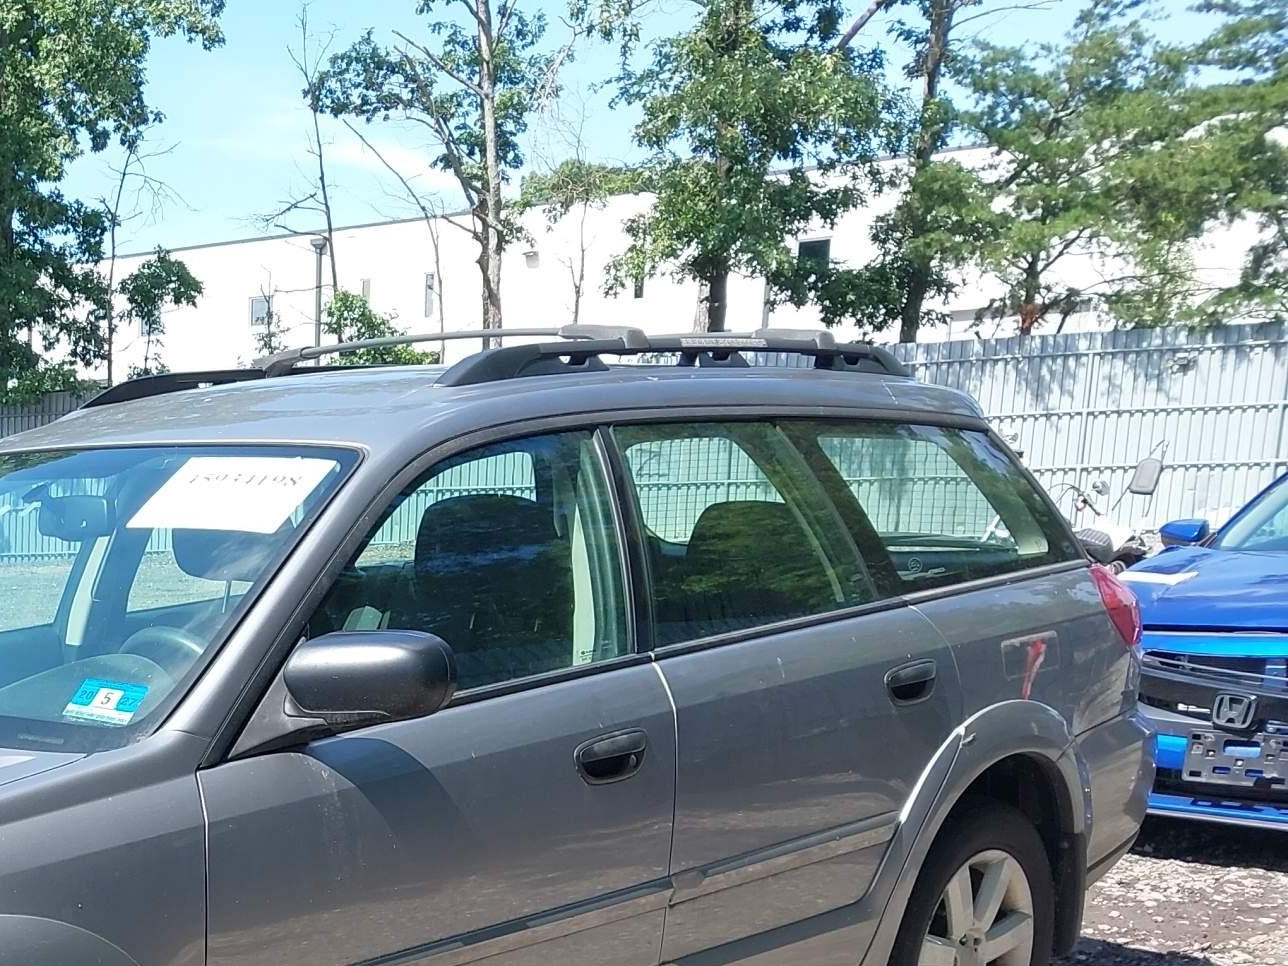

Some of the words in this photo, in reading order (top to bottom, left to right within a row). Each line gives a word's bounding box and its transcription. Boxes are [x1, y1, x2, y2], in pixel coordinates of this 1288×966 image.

[79, 689, 94, 700] 20
[100, 691, 116, 705] 5
[119, 696, 138, 706] 27
